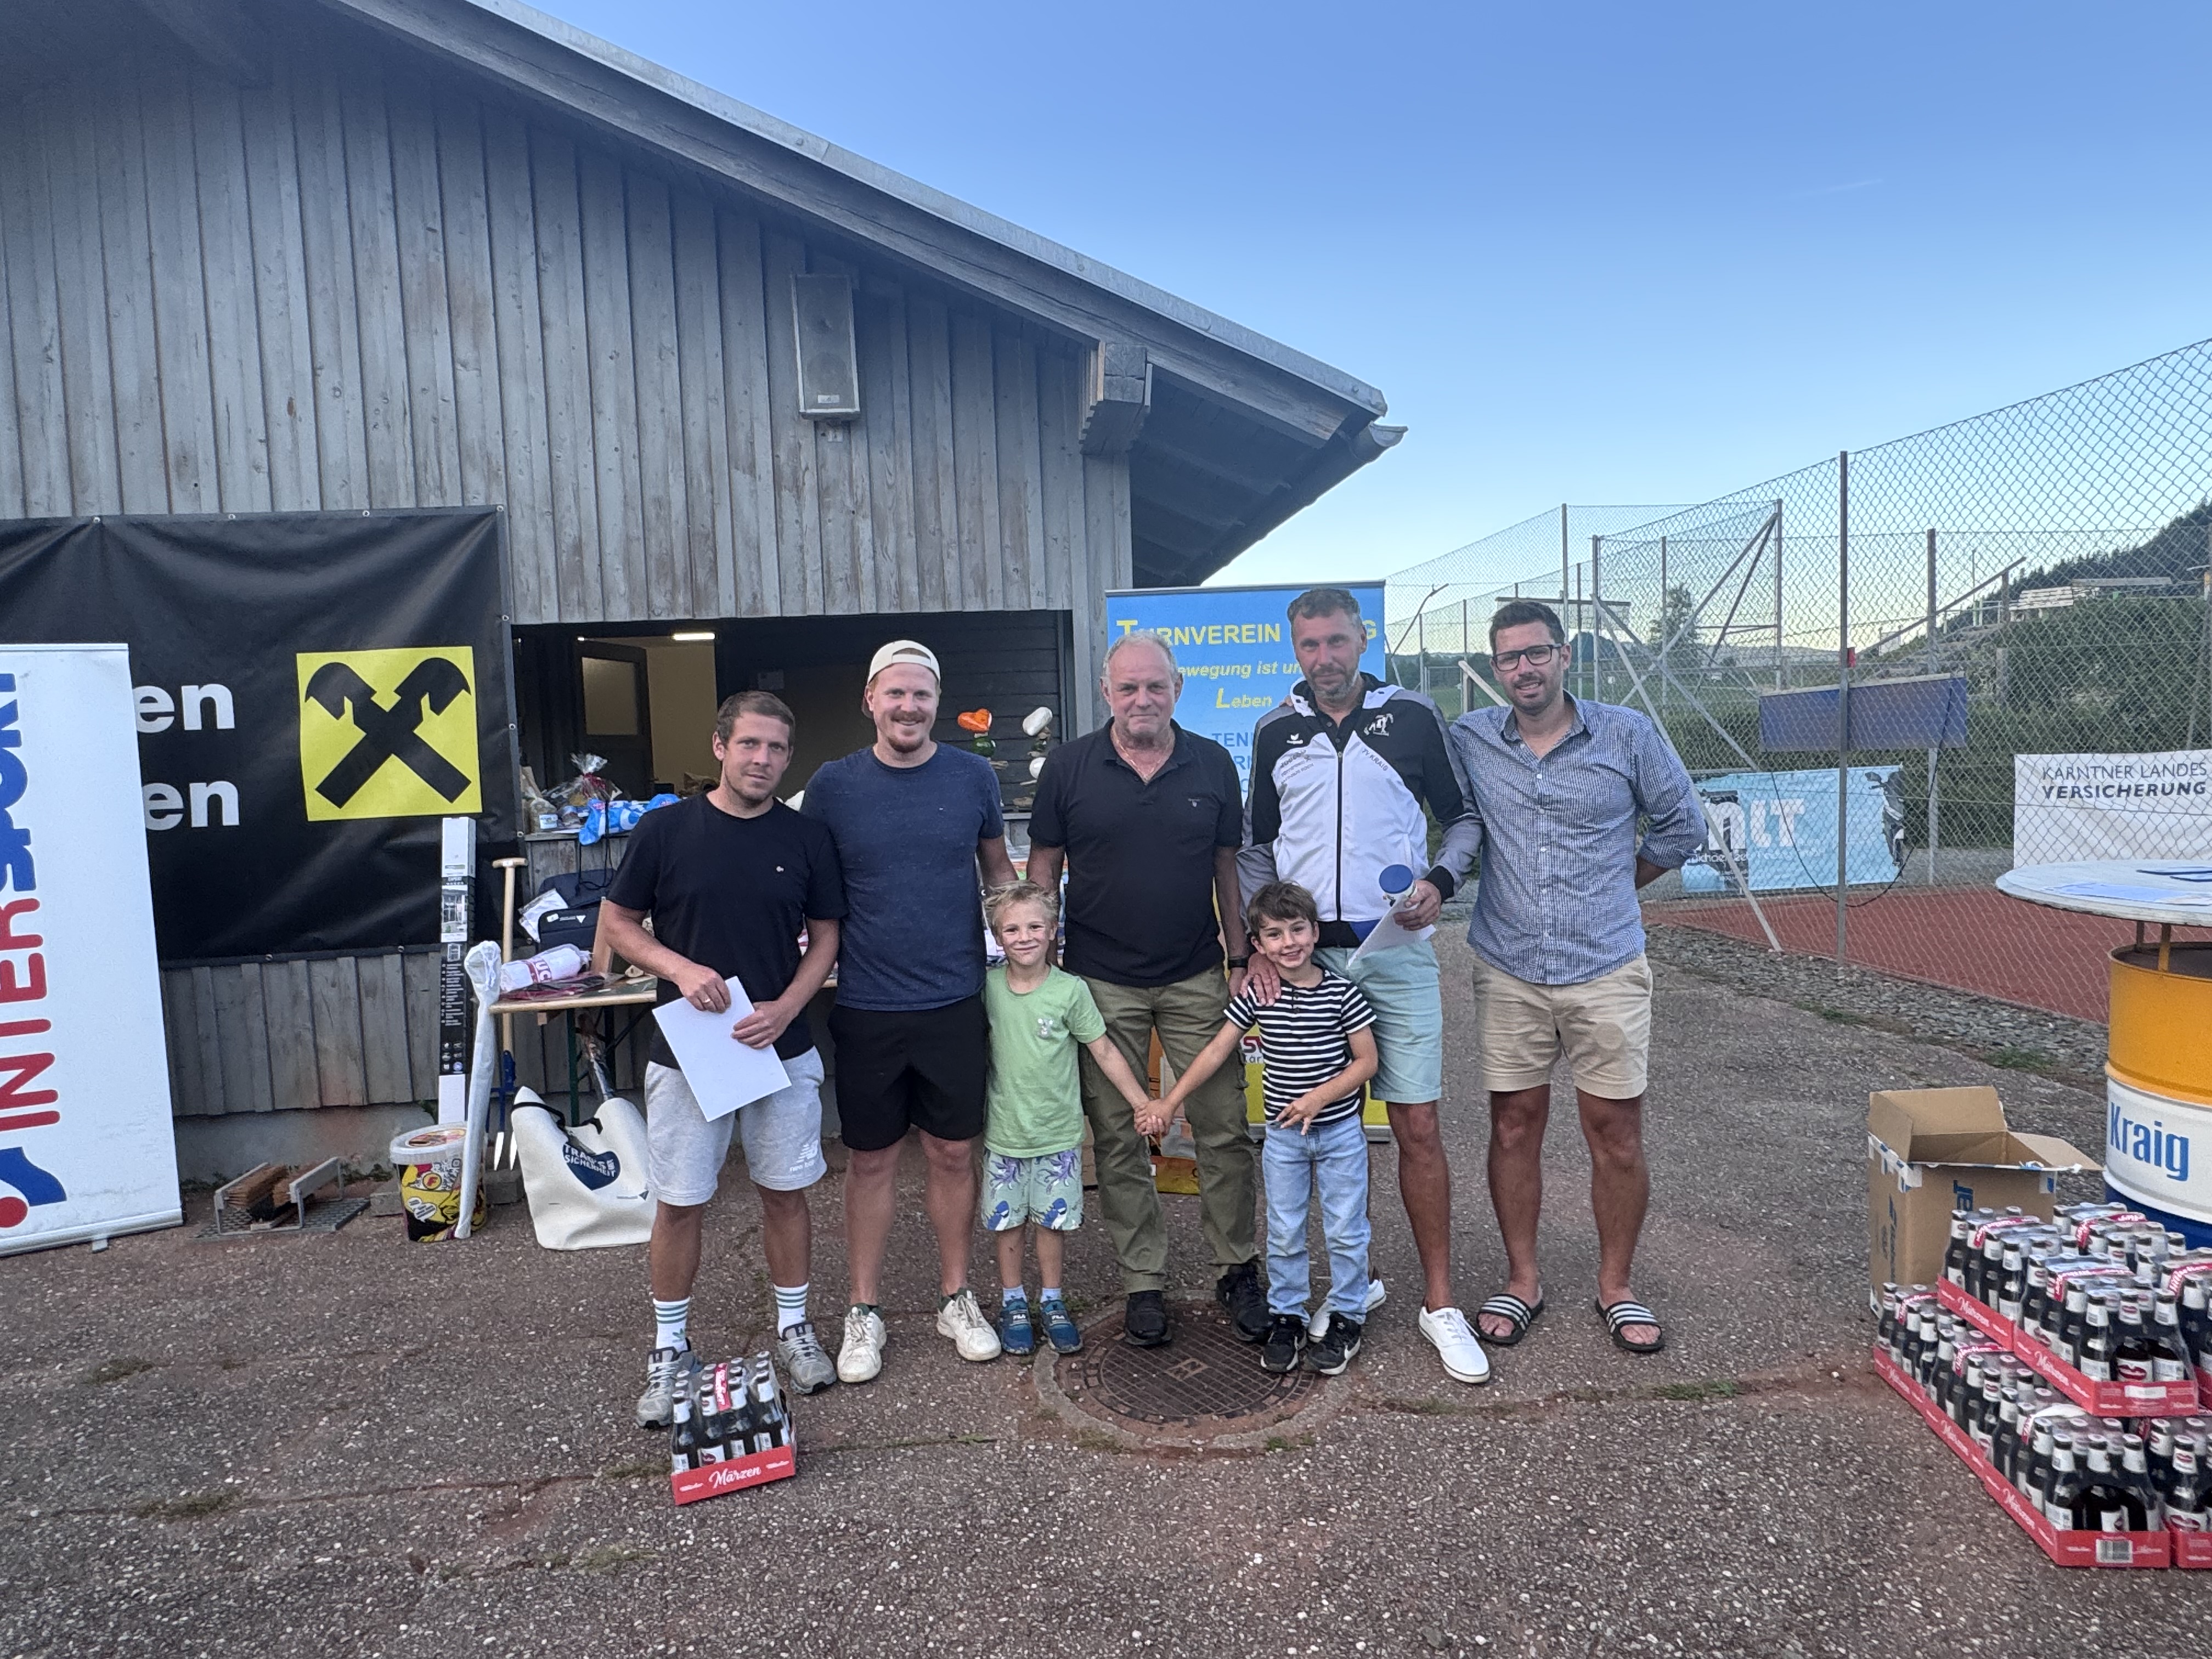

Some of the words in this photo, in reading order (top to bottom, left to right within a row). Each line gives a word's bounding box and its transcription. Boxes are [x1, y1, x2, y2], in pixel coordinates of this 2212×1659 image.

[1116, 620, 1280, 646] TRNVEREIN
[1177, 662, 1251, 679] ewegung
[1256, 661, 1278, 674] ist
[1216, 688, 1272, 708] Leben
[2141, 761, 2207, 778] LANDES
[2042, 781, 2206, 799] VERSICHERUNG
[2110, 1102, 2190, 1182] Kraig
[708, 1468, 761, 1489] Märzen
